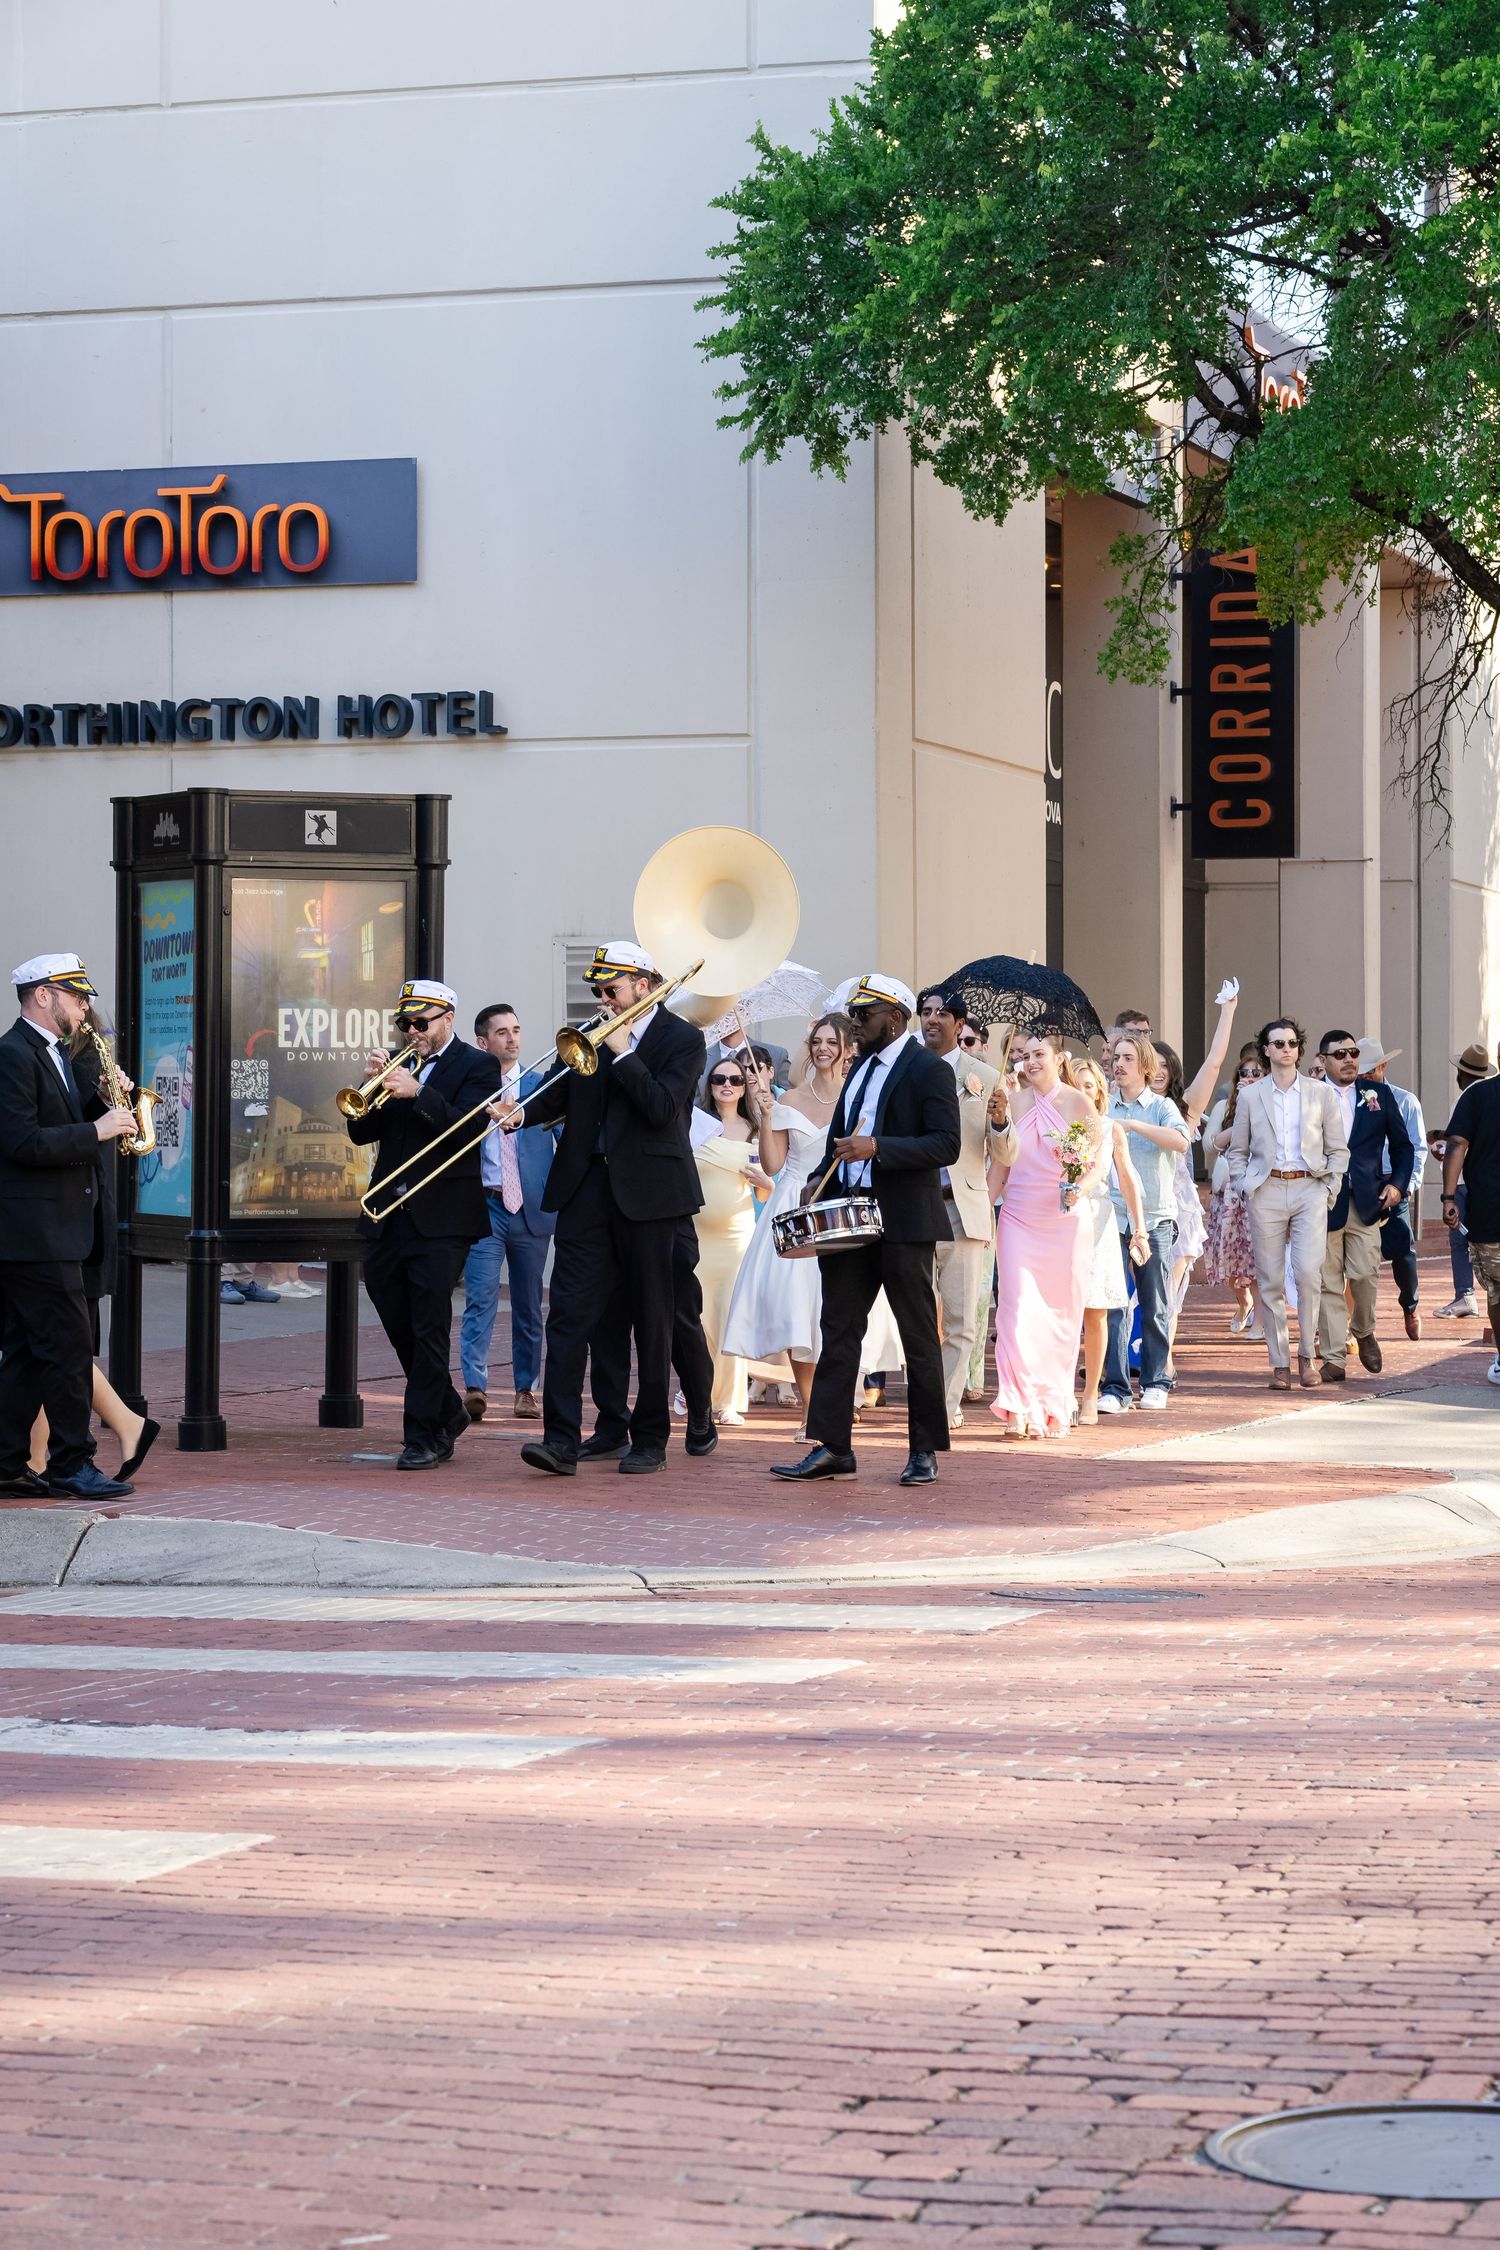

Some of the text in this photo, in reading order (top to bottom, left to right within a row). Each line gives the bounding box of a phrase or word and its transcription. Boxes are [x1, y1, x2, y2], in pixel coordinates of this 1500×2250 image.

[0, 474, 329, 581] ToroToro
[1209, 546, 1271, 828] CORRIDA
[337, 690, 508, 738] HOTEL
[260, 888, 283, 898] Lounge
[152, 962, 187, 982] FORT WORTH
[278, 1008, 397, 1048] EXPLORE
[244, 1208, 285, 1216] Performance
